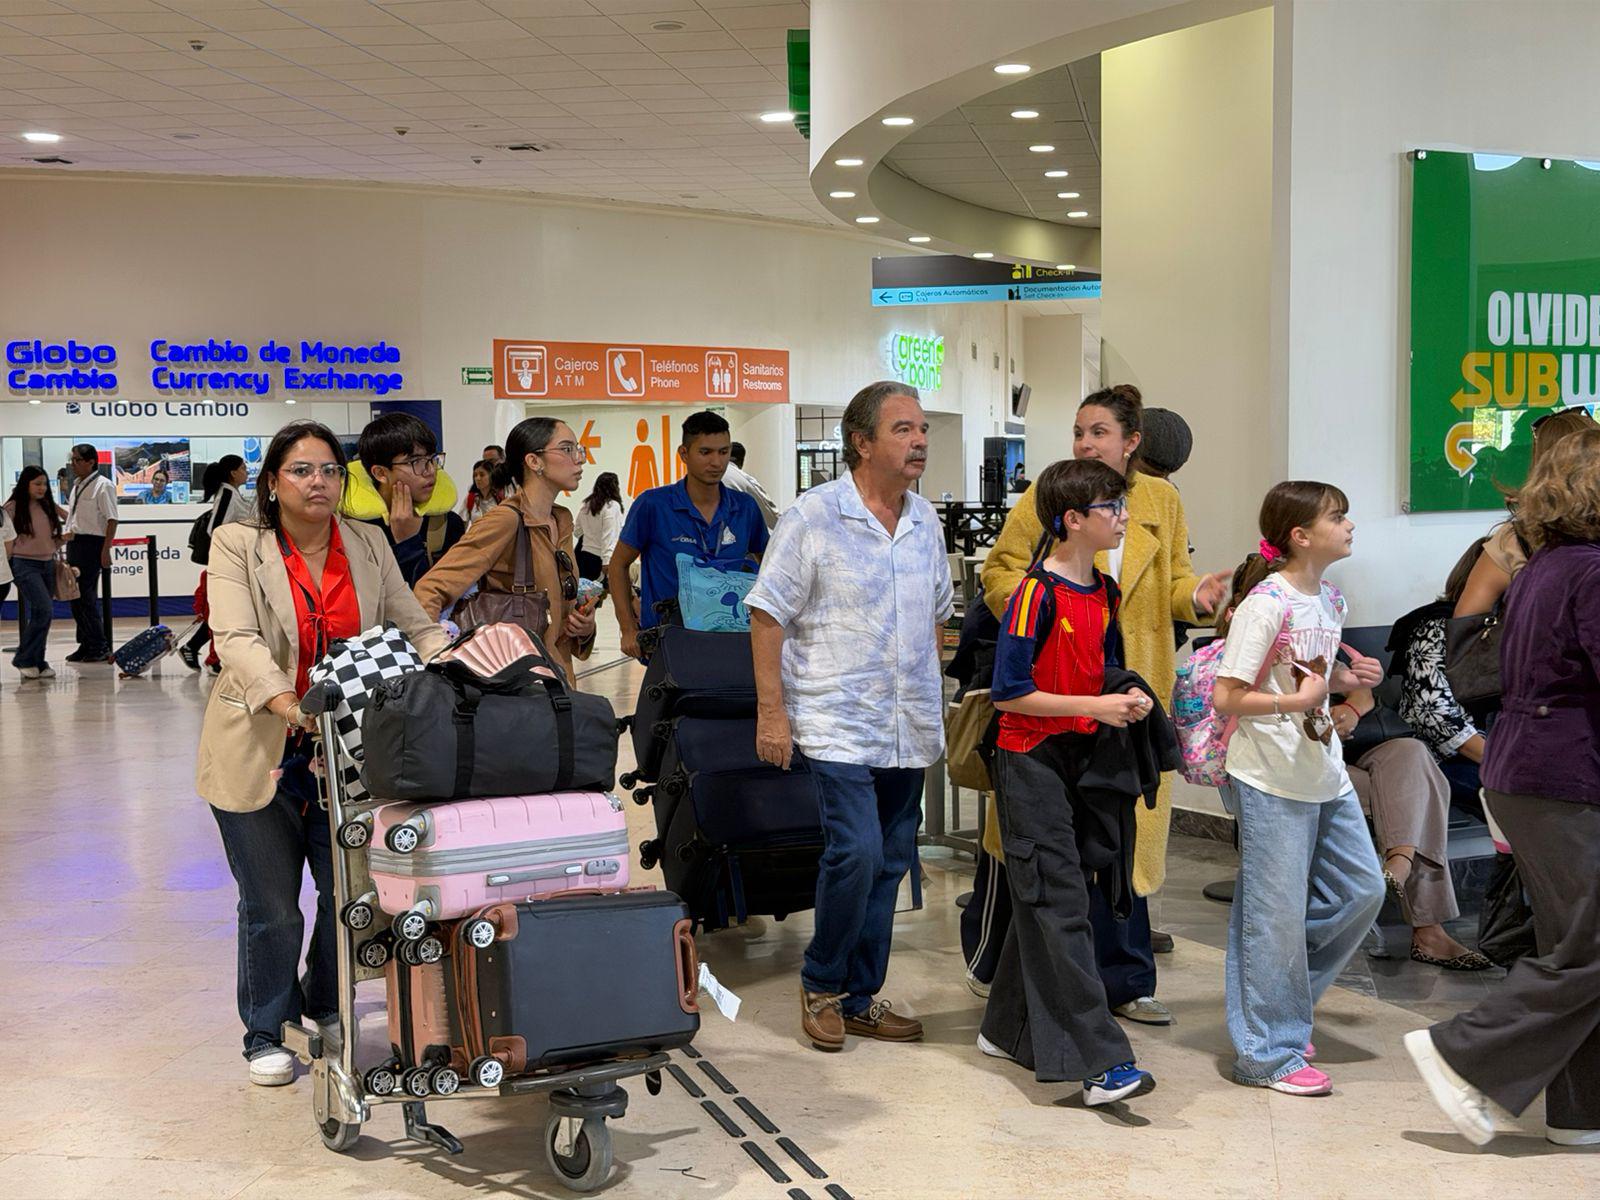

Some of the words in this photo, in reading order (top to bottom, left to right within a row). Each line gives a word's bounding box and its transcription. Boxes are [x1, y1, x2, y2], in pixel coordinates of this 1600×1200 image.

[915, 290, 941, 298] Cajeros
[6, 340, 117, 364] Globo
[151, 338, 248, 362] Cambio
[259, 340, 291, 363] de
[301, 341, 401, 363] Moneda
[899, 335, 935, 370] green
[554, 357, 600, 373] Cajeros
[650, 359, 699, 373] Teléfonos
[742, 362, 784, 377] Sanitarios
[8, 368, 118, 389] Cambio
[152, 366, 270, 395] Currency
[284, 367, 403, 395] Exchange
[650, 376, 680, 388] Phone
[742, 378, 782, 391] Restrooms
[91, 401, 157, 417] Globo
